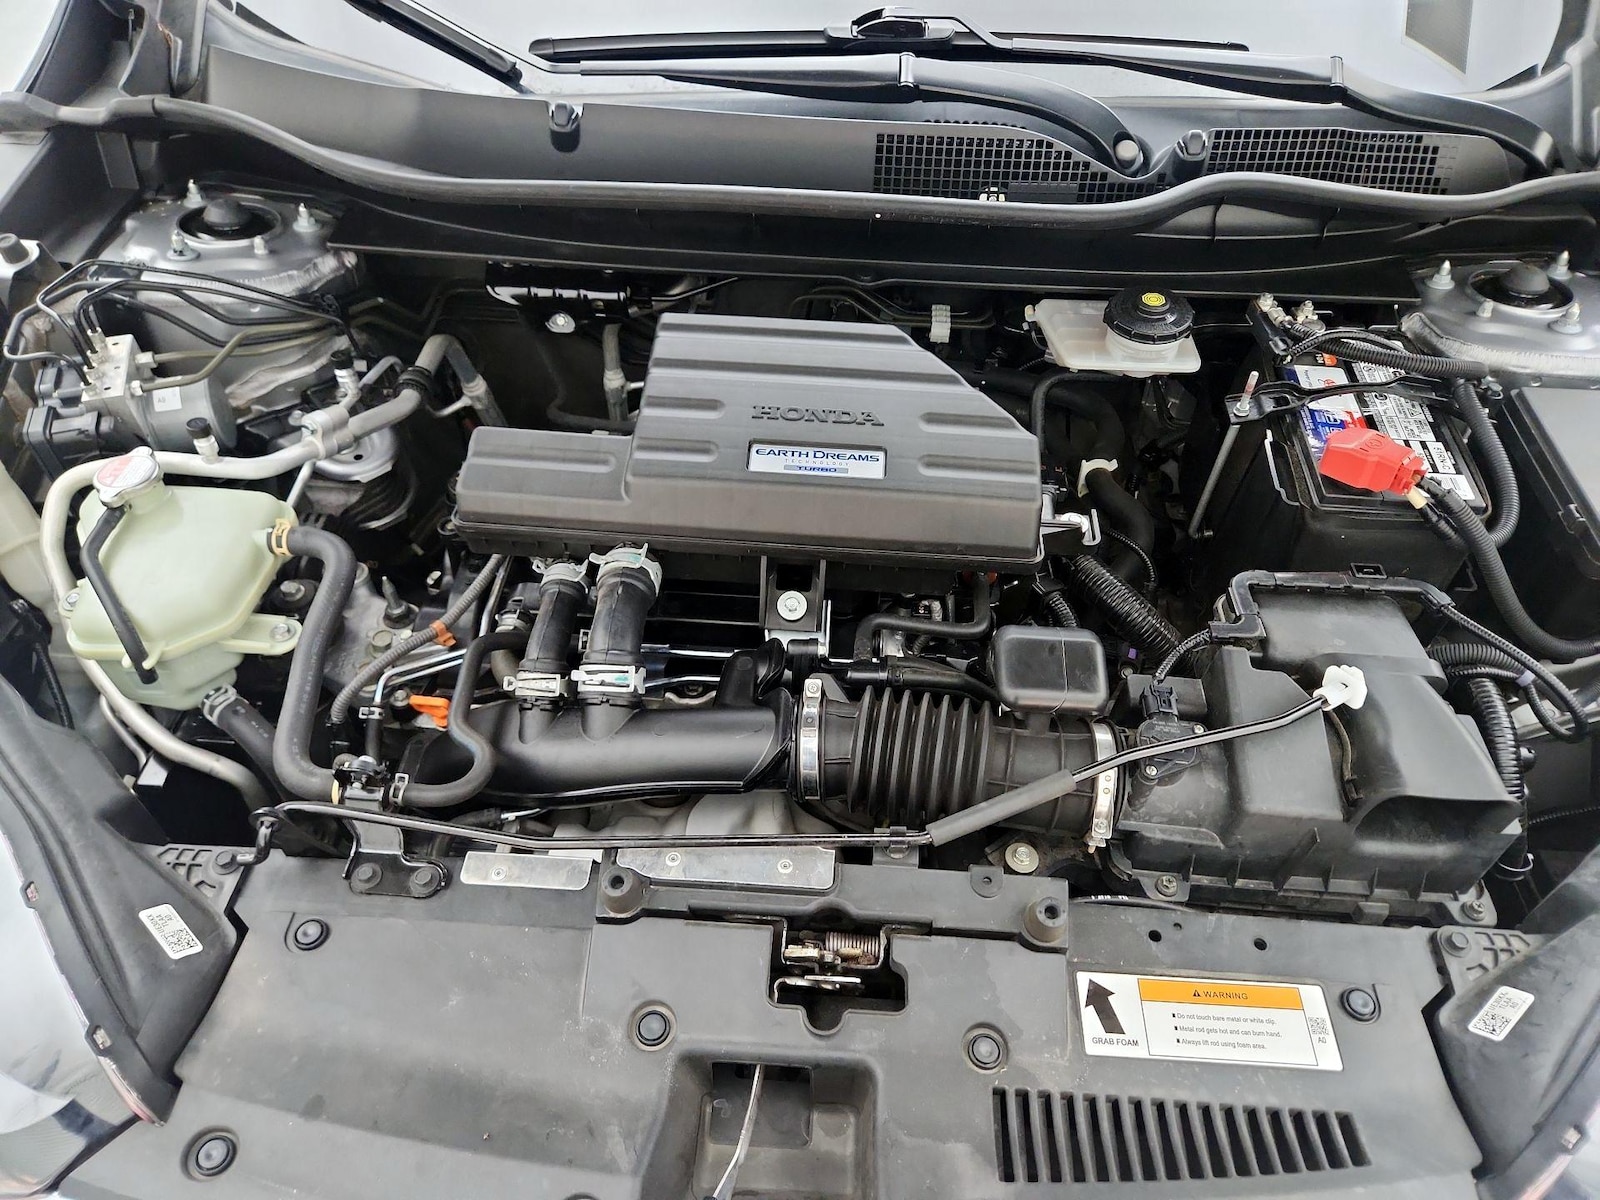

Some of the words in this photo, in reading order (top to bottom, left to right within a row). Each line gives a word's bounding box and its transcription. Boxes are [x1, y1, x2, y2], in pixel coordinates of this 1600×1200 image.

[751, 405, 885, 427] HONDA
[755, 448, 809, 458] EARTH
[813, 450, 880, 462] DREAMS
[785, 458, 849, 466] TECHNOLOGY
[1204, 991, 1249, 1000] WARNING
[1265, 1018, 1277, 1026] clip.
[1092, 1037, 1115, 1046] GRAB
[1116, 1038, 1140, 1047] FOAM
[1181, 1038, 1202, 1047] Always
[1220, 1041, 1236, 1049] using
[1236, 1041, 1252, 1049] foam
